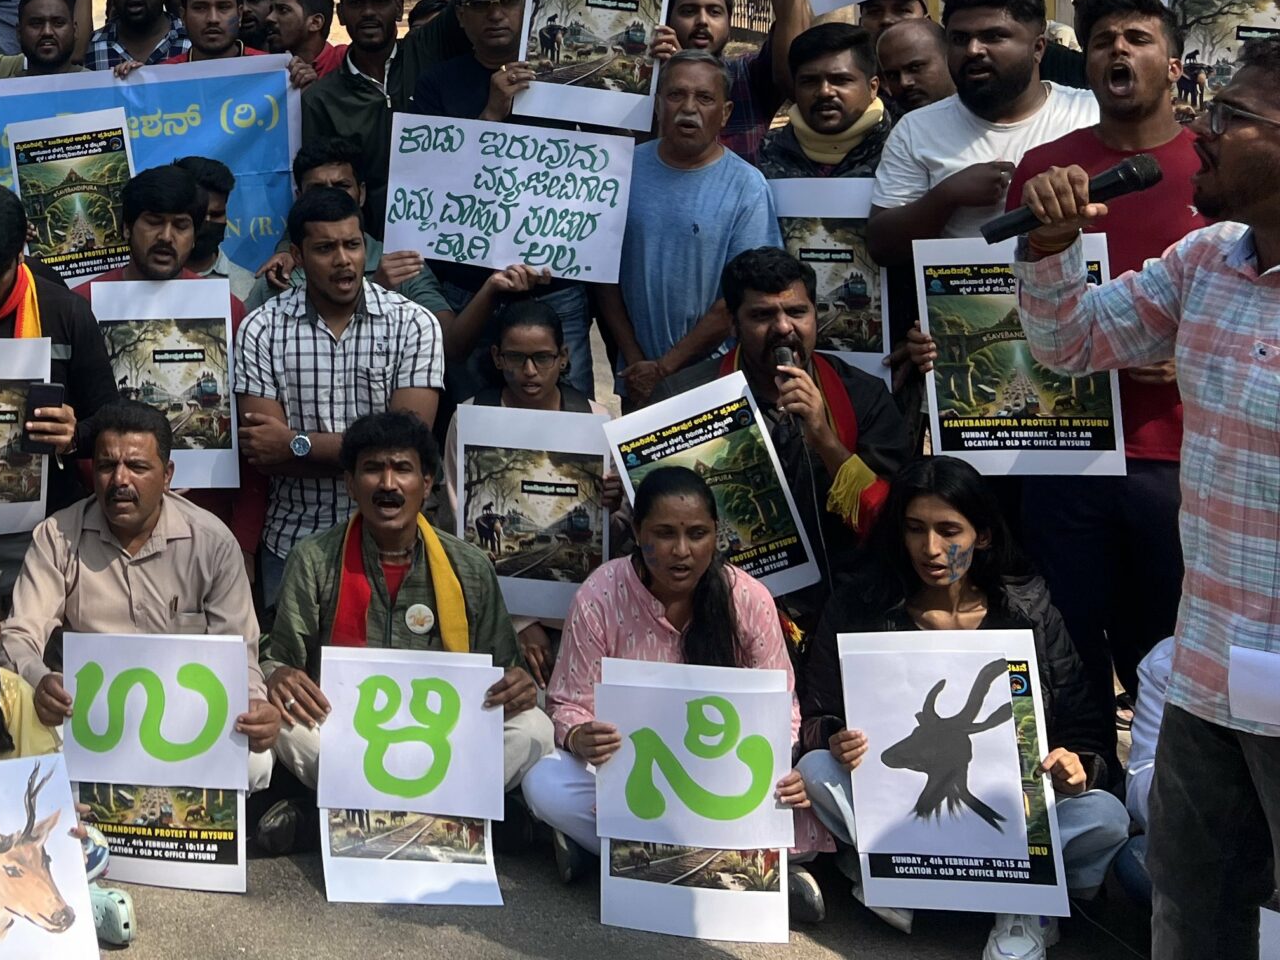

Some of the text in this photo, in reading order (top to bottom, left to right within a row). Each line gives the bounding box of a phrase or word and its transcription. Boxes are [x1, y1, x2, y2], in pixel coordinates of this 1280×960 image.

[399, 125, 464, 153] ಕಾಡು
[388, 188, 437, 231] ನಿಮ್ಮ
[440, 192, 520, 236] ವಾಹನ
[944, 419, 1018, 427] #SAVEBANDIPURA
[1021, 419, 1056, 427] PROTEST
[1072, 419, 1109, 427] MYSURU
[730, 548, 758, 563] PROTEST
[769, 537, 797, 551] MYSURU
[73, 664, 227, 760] ಉ
[628, 698, 773, 819] ಸಿ
[94, 823, 234, 840] AVEBANDIPURA PROTEST IN MYSURU
[111, 845, 215, 860] CATION OLD DC OFFICE MYSURU
[145, 840, 178, 849] FEBRUARY
[185, 842, 204, 851] 10:15
[206, 844, 218, 852] AM
[892, 856, 921, 864] SUNDAY
[944, 857, 984, 866] FEBRUARY
[992, 860, 1014, 868] 10:15
[1018, 861, 1030, 869] AM
[895, 866, 1030, 879] LOCATION OLD DC OFFICE MYSURU
